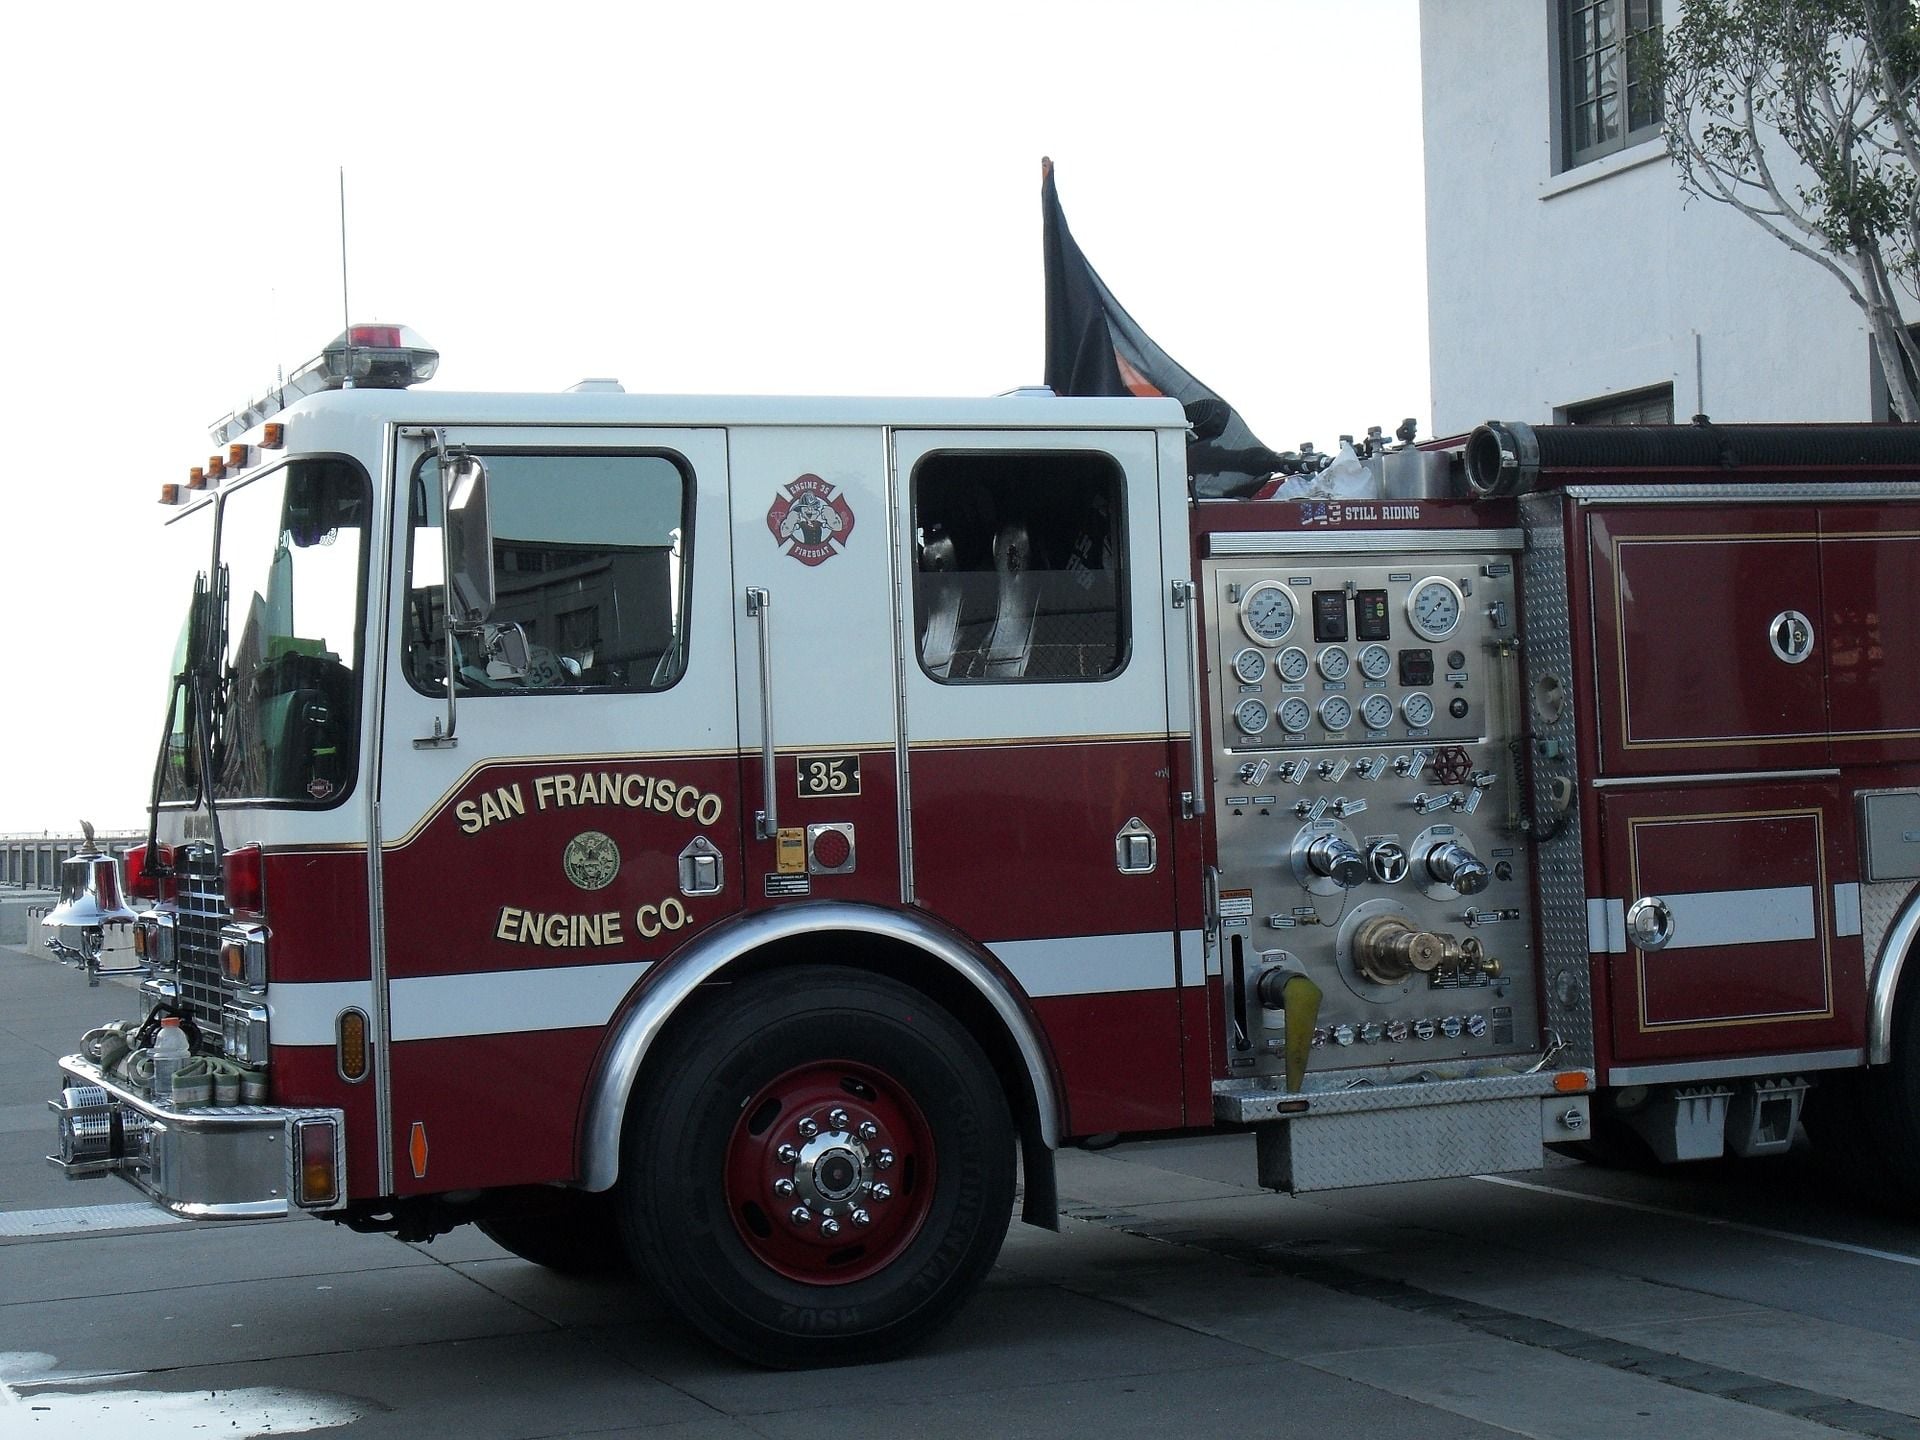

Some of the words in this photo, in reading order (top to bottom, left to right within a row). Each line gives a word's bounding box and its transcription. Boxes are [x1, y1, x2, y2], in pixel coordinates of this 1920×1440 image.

[789, 481, 818, 495] ENGINE
[820, 484, 830, 495] 35
[1345, 506, 1378, 521] STILL
[1382, 505, 1420, 520] RIDING
[794, 545, 830, 558] FIREBOAT
[809, 759, 848, 792] 35
[455, 783, 525, 834] SAN
[534, 772, 723, 827] FRANCISCO
[496, 906, 624, 948] ENGINE
[636, 897, 694, 938] CO.
